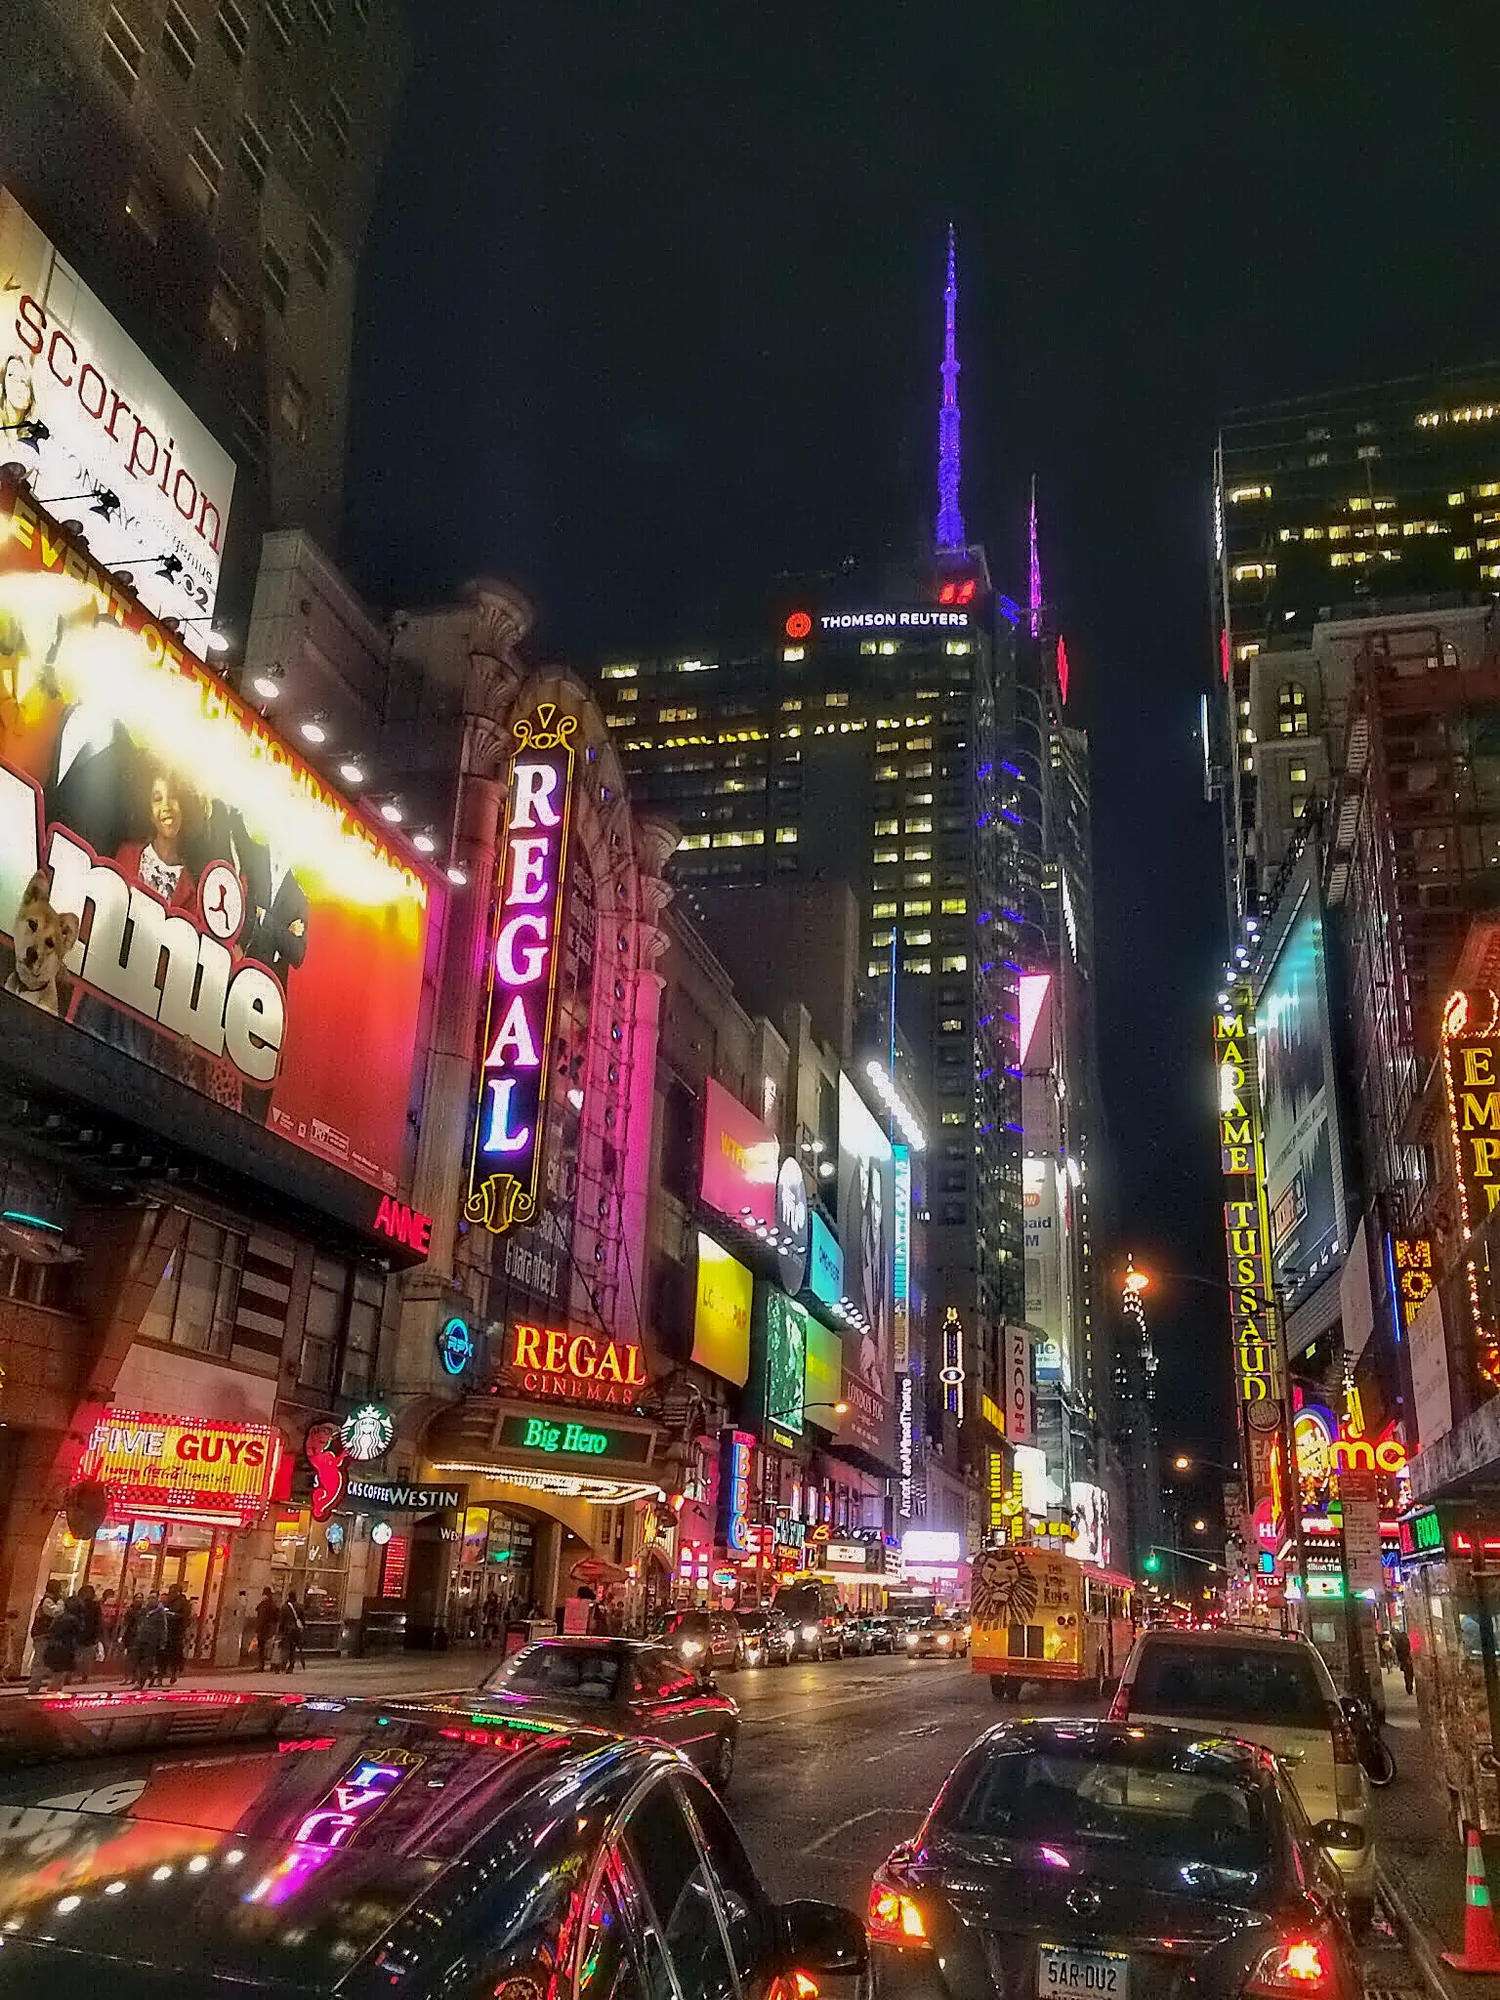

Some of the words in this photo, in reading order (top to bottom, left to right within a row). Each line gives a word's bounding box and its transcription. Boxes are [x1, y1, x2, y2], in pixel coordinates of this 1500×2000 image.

[15, 295, 220, 556] scorpion
[12, 496, 133, 626] EVENT
[820, 613, 896, 629] THOMSON
[899, 612, 968, 626] REUTERS
[482, 763, 561, 1153] REGAL
[1216, 1014, 1253, 1173] MADAME
[512, 1323, 648, 1386] REGAL
[523, 1373, 633, 1404] CINEMAS
[1014, 1335, 1025, 1433] RICOH
[88, 1425, 165, 1457] FIVE
[175, 1433, 265, 1467] GUYS
[523, 1418, 561, 1452] Big
[562, 1423, 608, 1454] Hero
[389, 1486, 459, 1508] WESTIN
[1043, 1589, 1070, 1603] KING
